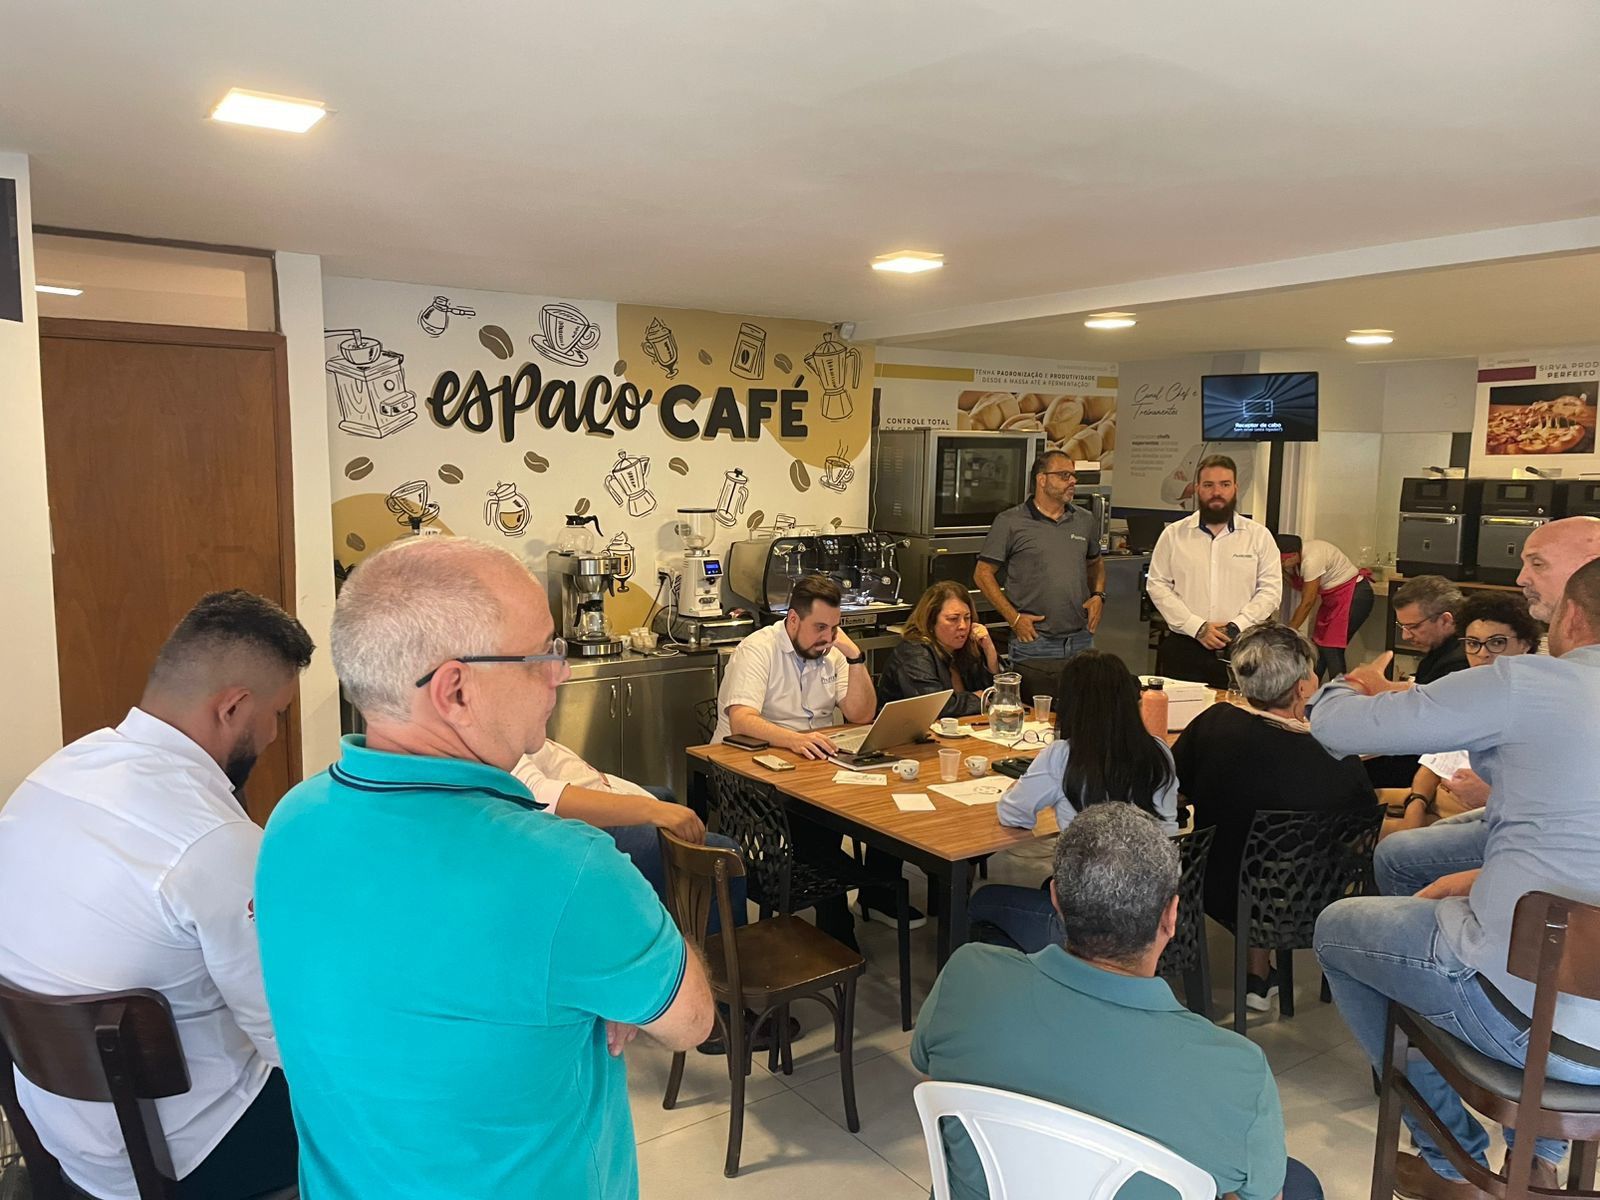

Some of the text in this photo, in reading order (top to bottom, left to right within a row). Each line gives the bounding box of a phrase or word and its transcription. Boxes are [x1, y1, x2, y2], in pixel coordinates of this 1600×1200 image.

[1539, 364, 1567, 372] SIRVA
[997, 370, 1043, 379] PADRONIZAÇÃO
[1547, 369, 1596, 378] PERFEITO
[426, 362, 810, 443] espaço CAFÉ
[928, 418, 950, 426] TOTAL
